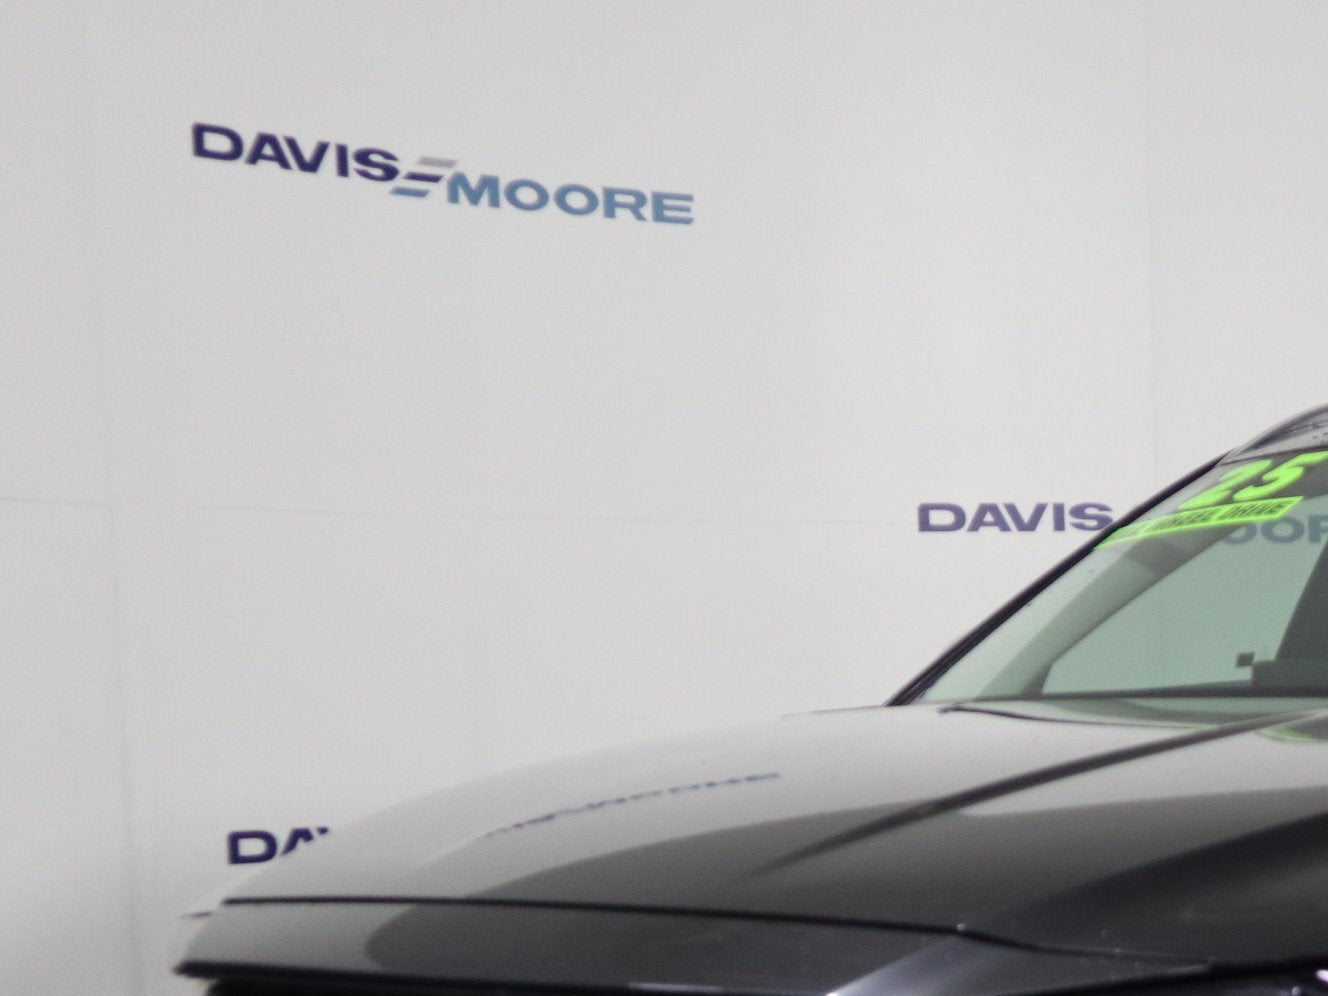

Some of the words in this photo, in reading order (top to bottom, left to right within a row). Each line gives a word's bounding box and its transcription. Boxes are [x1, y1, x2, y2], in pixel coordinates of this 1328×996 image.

[191, 122, 400, 183] DAVIS
[447, 172, 694, 225] MOORE
[918, 502, 1114, 532] DAVIS
